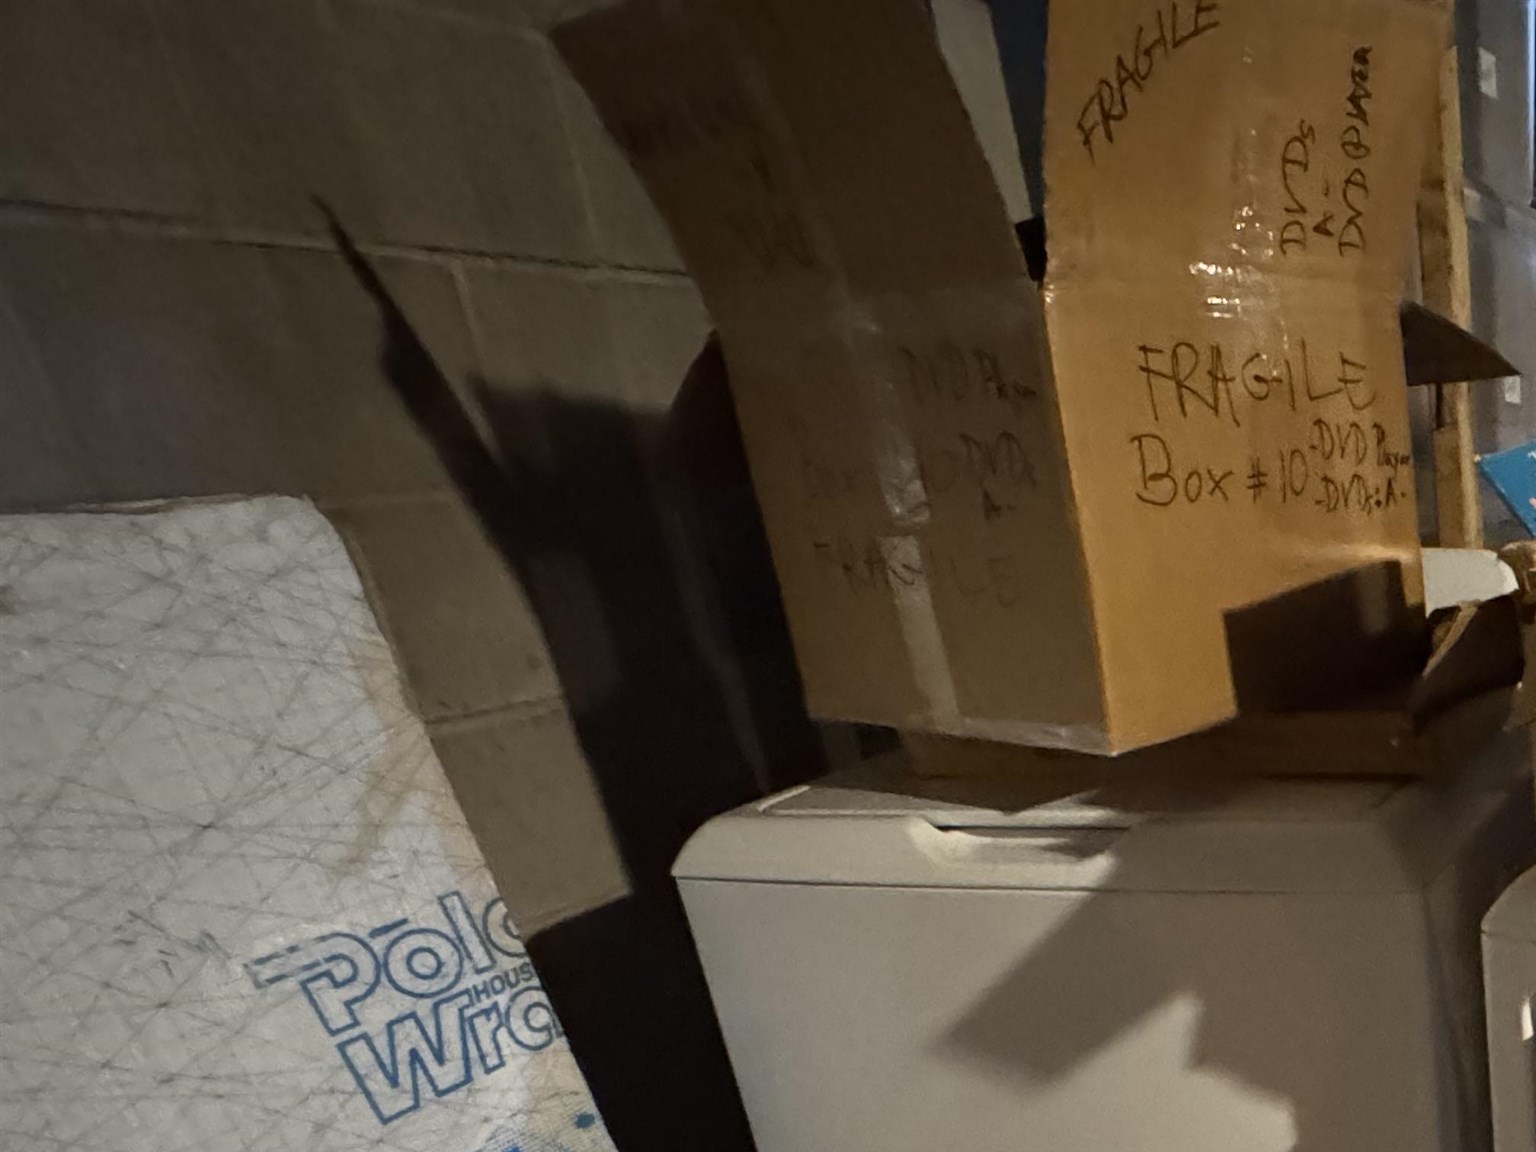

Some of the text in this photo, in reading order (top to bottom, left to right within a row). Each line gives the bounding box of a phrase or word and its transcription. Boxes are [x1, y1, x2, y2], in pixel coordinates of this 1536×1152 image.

[1076, 3, 1219, 165] FRAGILE
[1138, 338, 1379, 427] FRAGILE
[1131, 434, 1233, 506] Box
